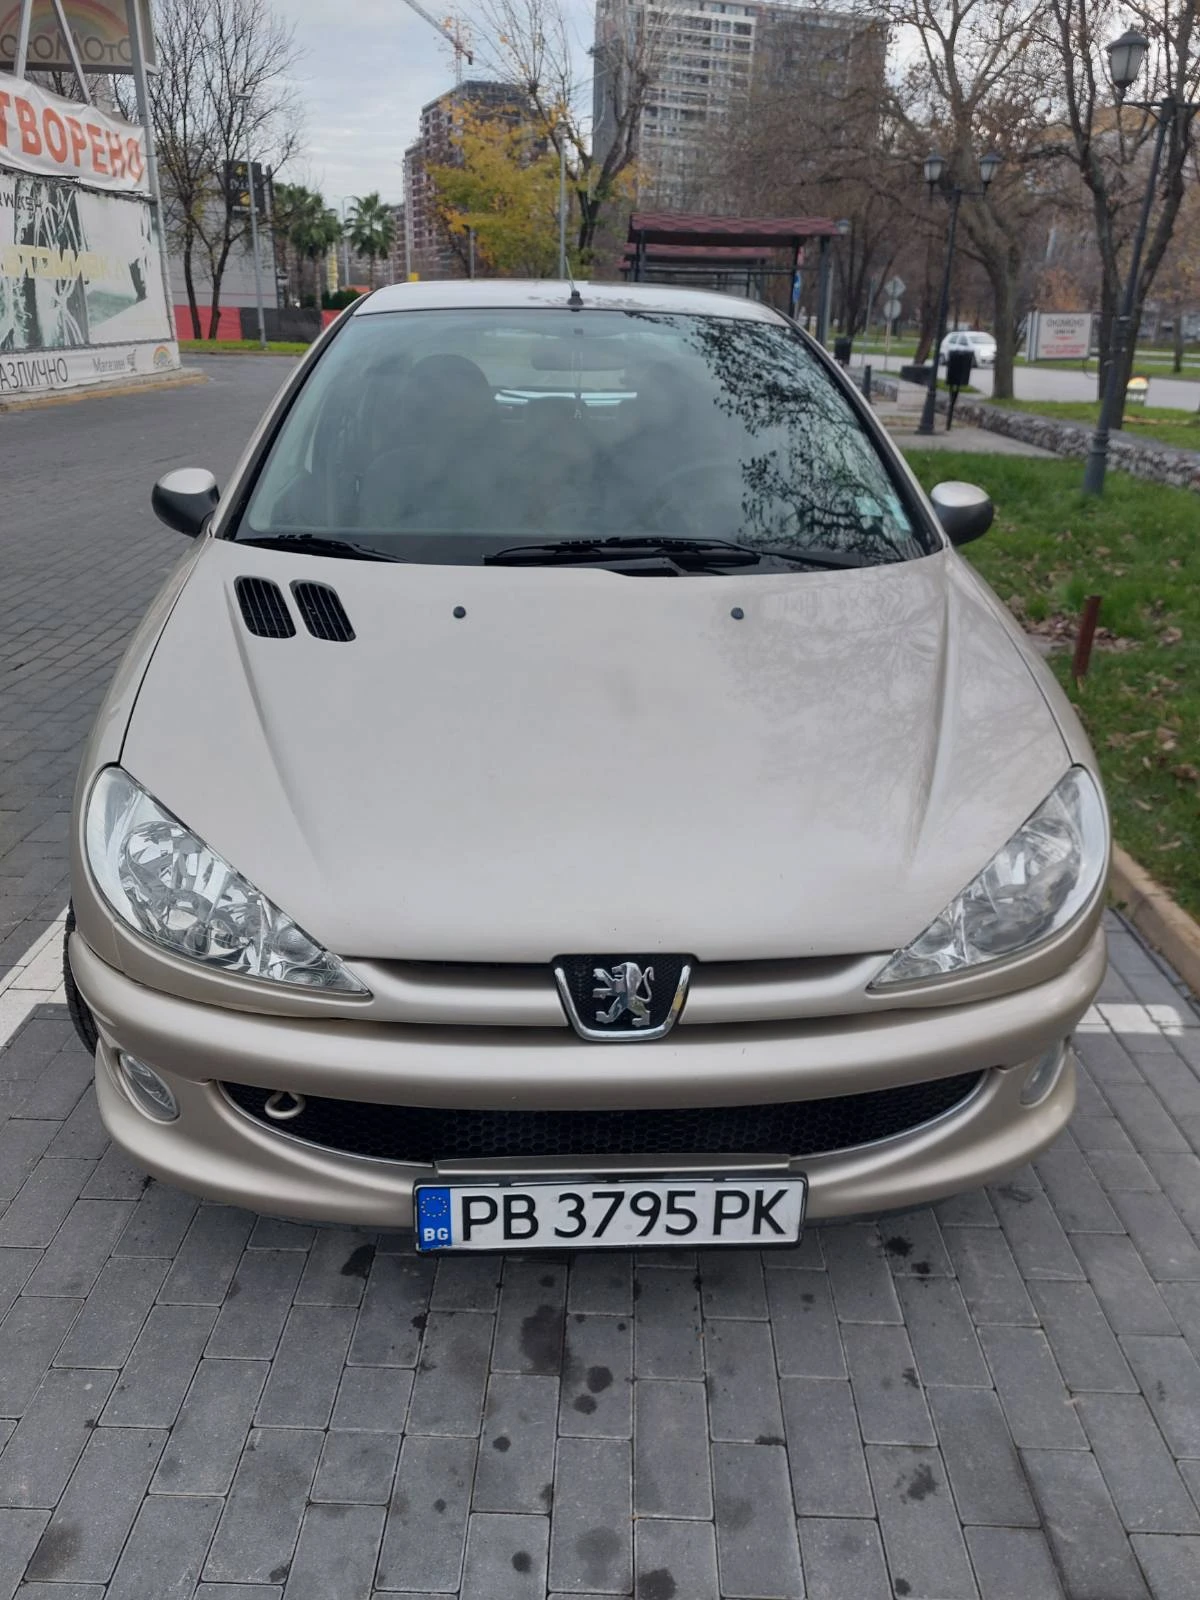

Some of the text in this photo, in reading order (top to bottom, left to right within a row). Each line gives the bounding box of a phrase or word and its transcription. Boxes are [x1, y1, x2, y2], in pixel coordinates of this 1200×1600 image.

[461, 1188, 790, 1242] PB 3795 PK
[423, 1227, 449, 1242] BG
